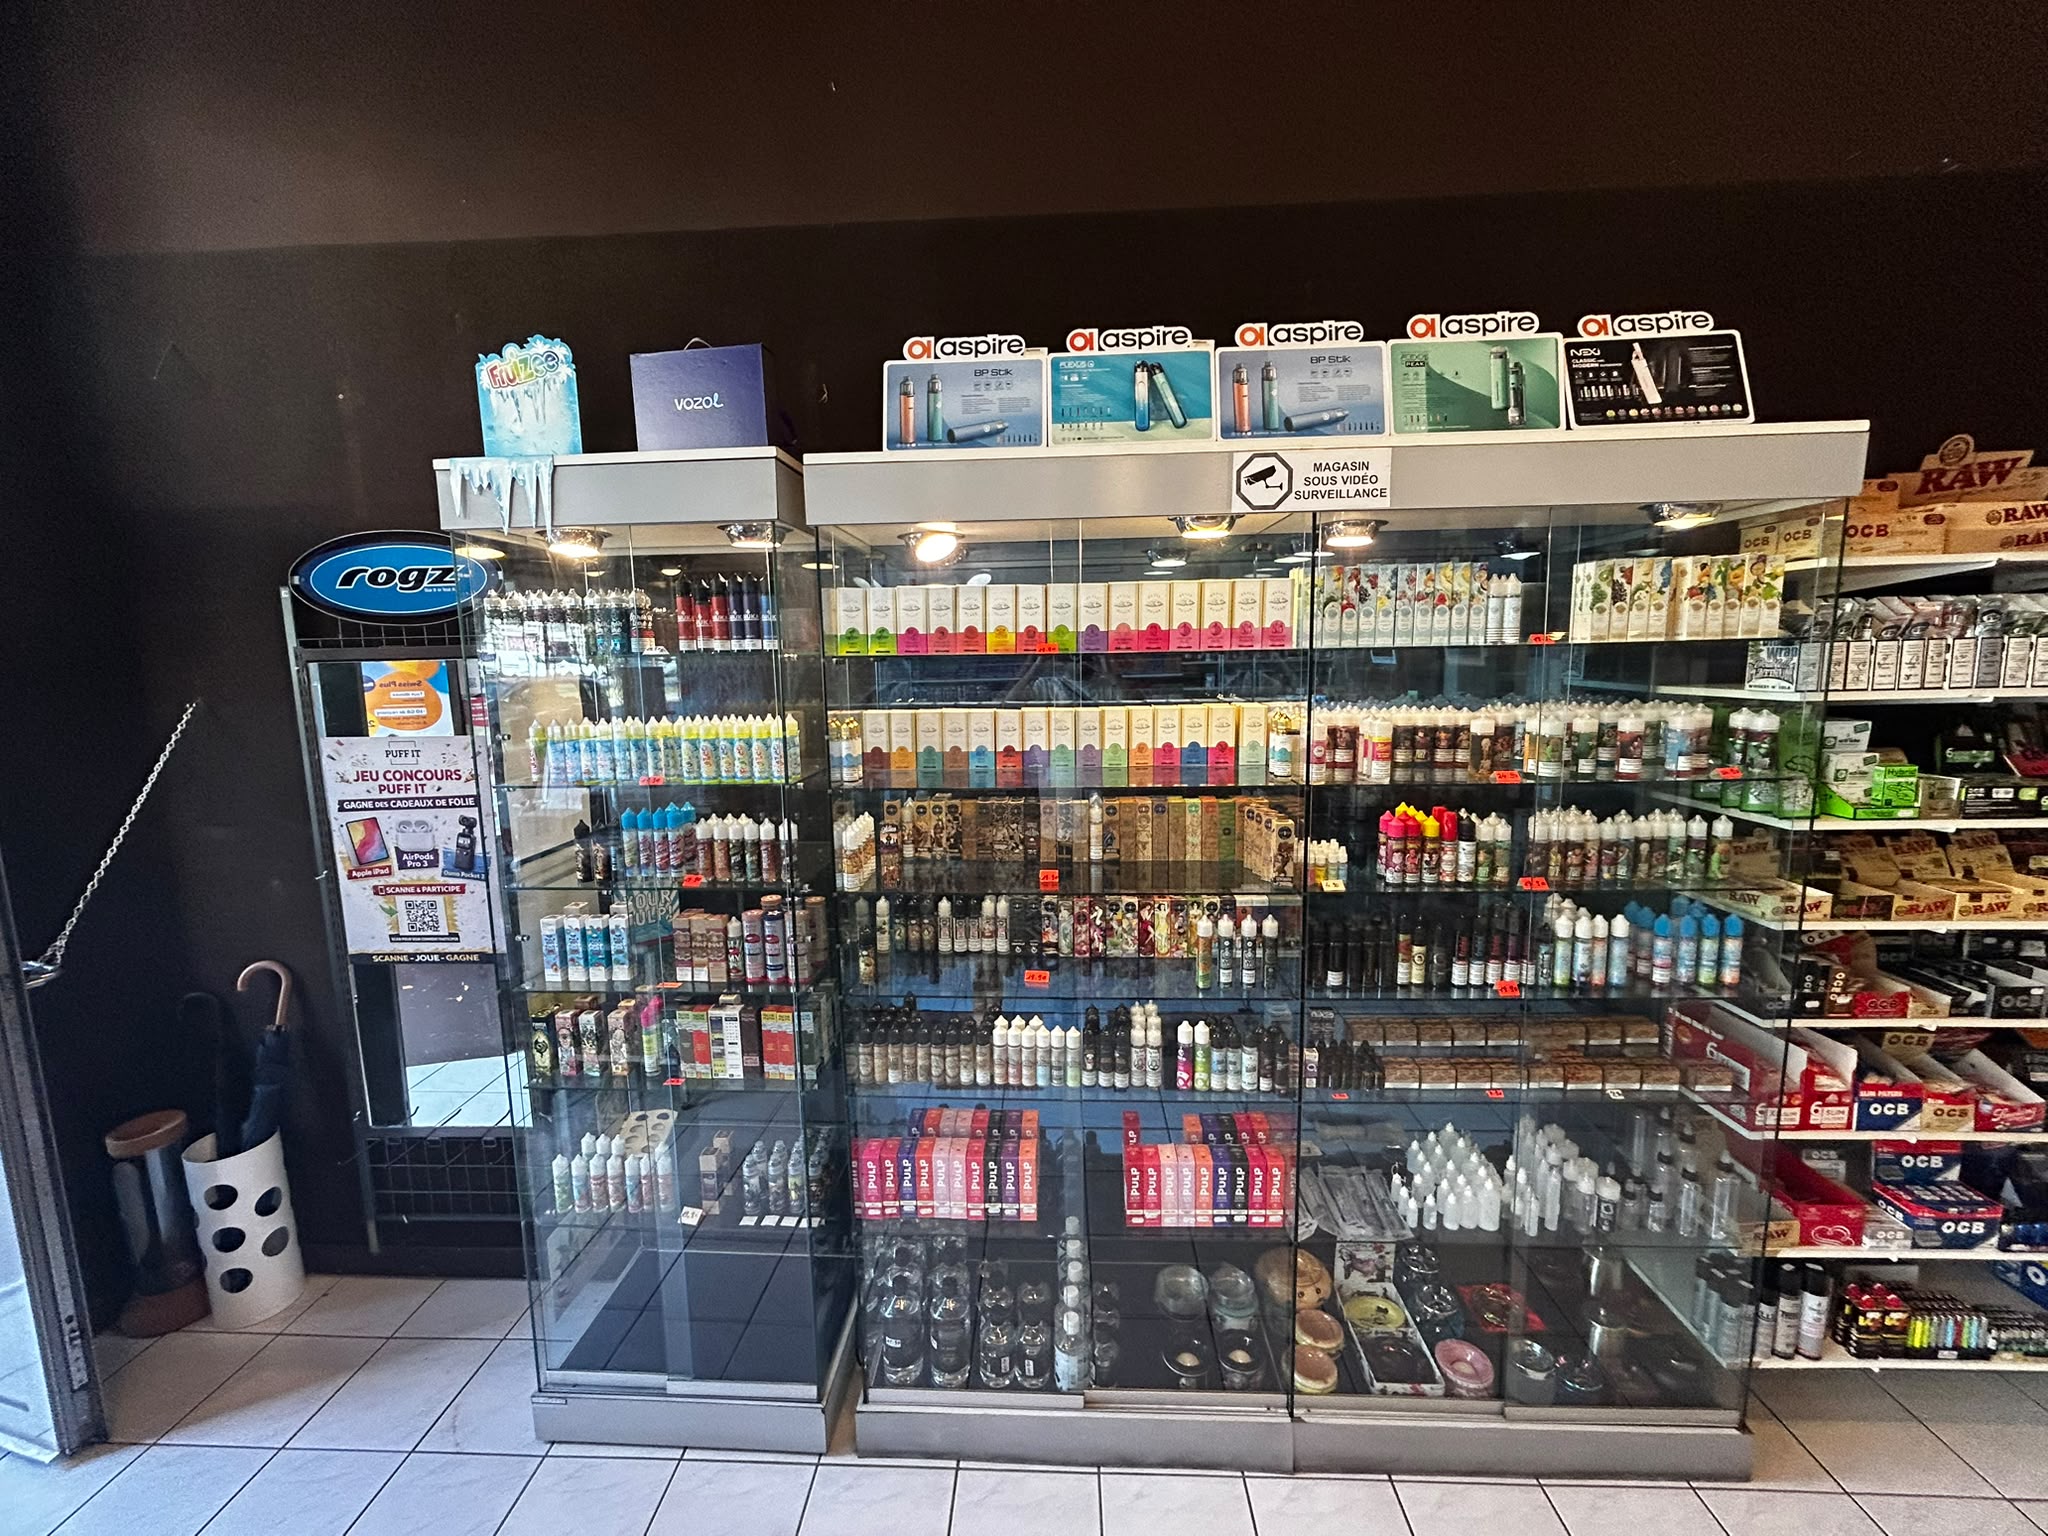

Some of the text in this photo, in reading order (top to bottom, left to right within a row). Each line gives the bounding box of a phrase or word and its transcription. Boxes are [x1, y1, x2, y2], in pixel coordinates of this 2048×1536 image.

[1273, 323, 1362, 345] aspire
[1444, 314, 1536, 336] aspire
[1617, 313, 1710, 334] aspire
[939, 334, 1024, 359] aspire
[1102, 327, 1190, 350] aspire
[487, 350, 559, 390] Fruizee
[1310, 355, 1351, 365] BP Stik
[974, 367, 1013, 377] BP Stik
[1313, 461, 1370, 473] MAGASIN
[1914, 456, 2025, 496] RAW
[1303, 472, 1379, 487] SOUS VIDÉO
[1294, 488, 1388, 500] SURVEILLANCE
[1783, 529, 1812, 543] OCB
[1845, 524, 1889, 538] OCB
[1743, 536, 1770, 549] OCB
[336, 565, 466, 593] rogz
[385, 749, 421, 759] PUFF IT
[353, 769, 462, 782] JEU CONCOURS
[378, 783, 427, 794] PUFF IT
[343, 801, 374, 810] GAGNE
[390, 799, 434, 808] CADEAUX
[436, 799, 447, 807] DE
[448, 797, 475, 806] FOLIE
[402, 853, 434, 861] AirPods
[351, 868, 390, 878] Apple iPad
[386, 886, 415, 894] SCANNE
[422, 885, 461, 893] PARTICIPE
[1729, 891, 1761, 906] RAW
[1905, 900, 1948, 915] RAW
[1973, 901, 2011, 915] RAW
[372, 954, 409, 962] SCANNE
[414, 954, 440, 962] JOUE
[446, 954, 480, 962] GAGNE
[1887, 1034, 1929, 1046] OCB
[1810, 1101, 1823, 1117] 6
[1869, 1103, 1910, 1116] OCB
[1933, 1108, 1969, 1118] OCB
[1812, 1151, 1838, 1159] OCB
[1901, 1155, 1943, 1168] OCB
[867, 1161, 877, 1189] PULP
[885, 1159, 894, 1188] PULP
[903, 1159, 913, 1187] PULP
[920, 1159, 930, 1187] PULP
[936, 1159, 946, 1187] PULP
[953, 1161, 963, 1188] PULP
[971, 1161, 980, 1190] PULP
[988, 1161, 998, 1190] PULP
[1005, 1162, 1015, 1190] PULP
[1023, 1162, 1033, 1190] PULP
[1130, 1167, 1140, 1196] PULP
[1147, 1167, 1157, 1196] PULP
[1165, 1167, 1175, 1196] PULP
[1182, 1167, 1192, 1196] PULP
[1200, 1167, 1210, 1196] PULP
[1217, 1167, 1228, 1196] PULP
[1235, 1167, 1246, 1196] PULP
[1253, 1167, 1263, 1196] PULP
[1271, 1167, 1281, 1196] PULP
[1877, 1200, 1905, 1221] OCB
[1876, 1231, 1905, 1239] OCB
[1941, 1221, 1985, 1234] OCB
